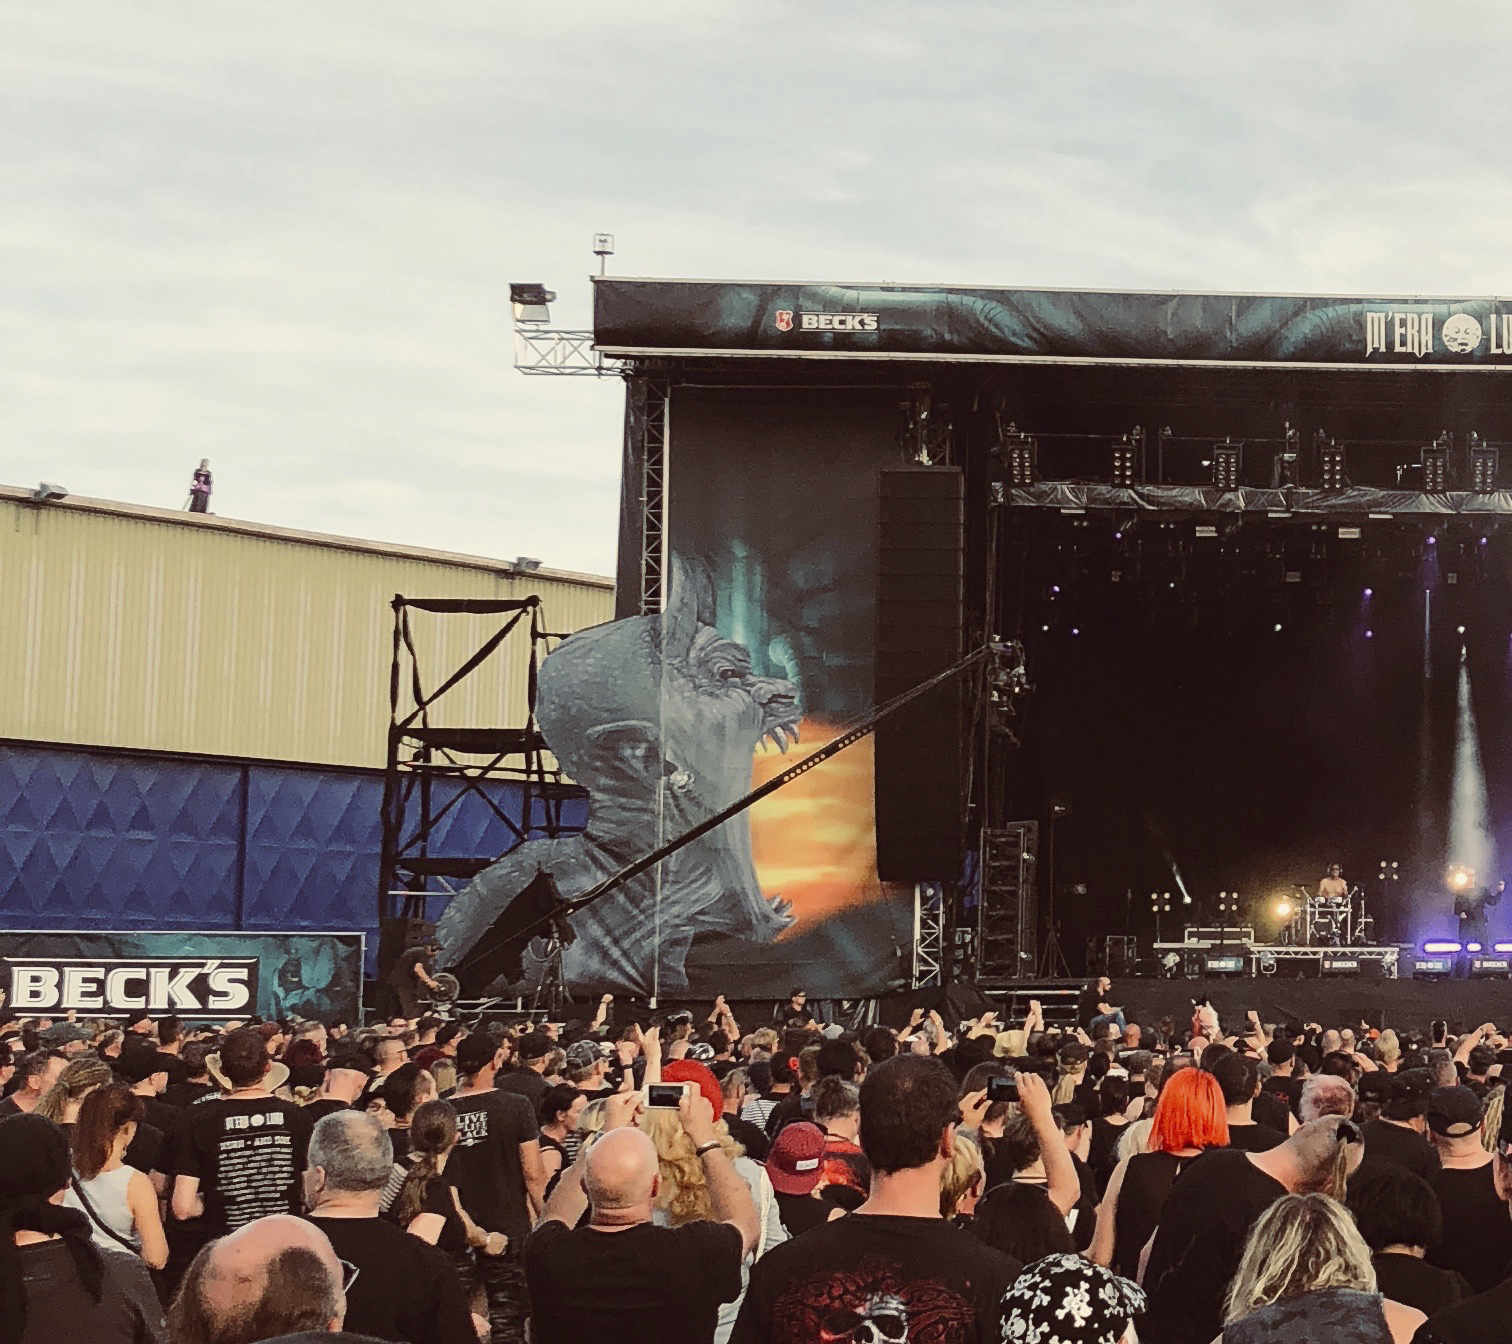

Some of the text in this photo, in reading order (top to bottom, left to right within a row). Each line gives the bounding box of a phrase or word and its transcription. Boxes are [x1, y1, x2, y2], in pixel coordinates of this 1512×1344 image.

[801, 313, 878, 330] BECK'S
[1365, 311, 1434, 358] M'ERA
[9, 959, 250, 1010] BECK'S
